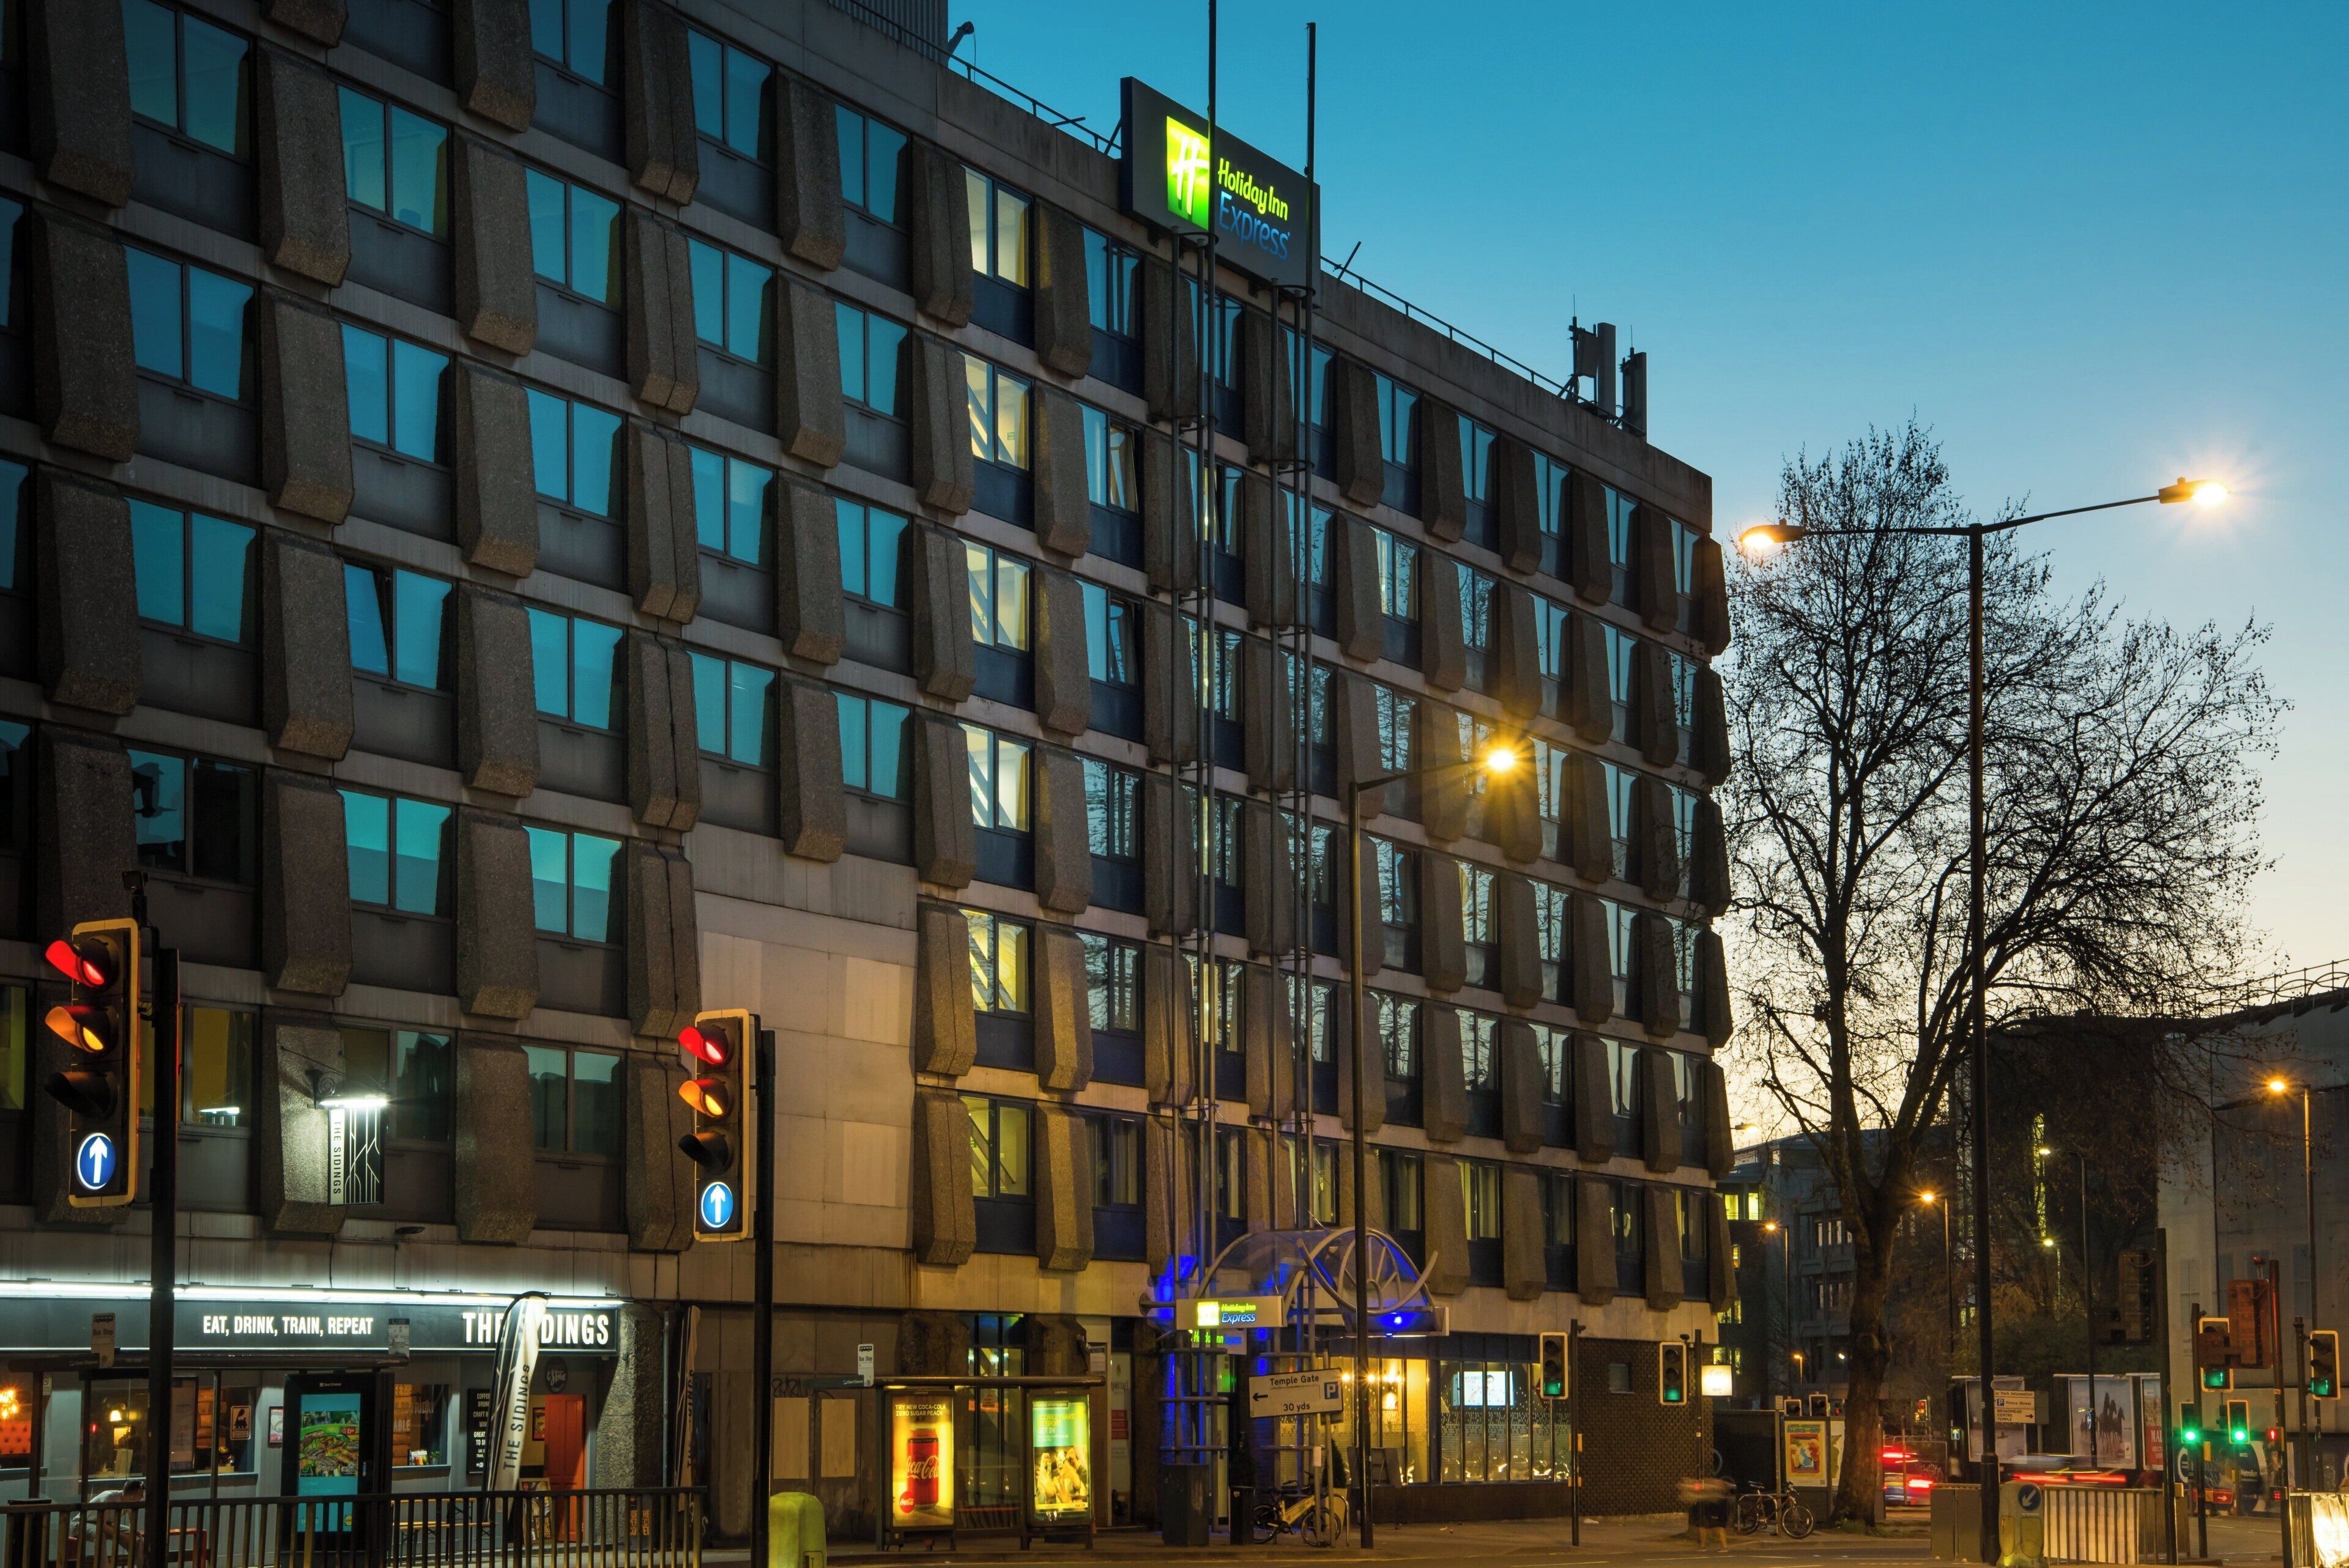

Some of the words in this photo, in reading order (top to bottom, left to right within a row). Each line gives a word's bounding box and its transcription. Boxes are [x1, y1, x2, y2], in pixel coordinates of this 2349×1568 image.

[1217, 157, 1267, 215] Holiday
[1269, 186, 1288, 221] Inn
[1218, 191, 1288, 260] Express
[333, 1147, 341, 1195] SIDINGS
[1221, 1304, 1245, 1312] Holiday
[1221, 1312, 1256, 1325] Express
[203, 1315, 229, 1336] EAT,
[234, 1316, 278, 1337] DRINK,
[282, 1317, 324, 1337] TRAIN,
[328, 1317, 374, 1335] REPEAT
[538, 1314, 609, 1345] DINGS
[1270, 1376, 1297, 1386] Temple
[1301, 1375, 1319, 1383] Gate
[511, 1364, 530, 1432] SIDINGS
[1283, 1403, 1294, 1411] 30
[1296, 1402, 1310, 1412] yds
[503, 1440, 520, 1470] THE
